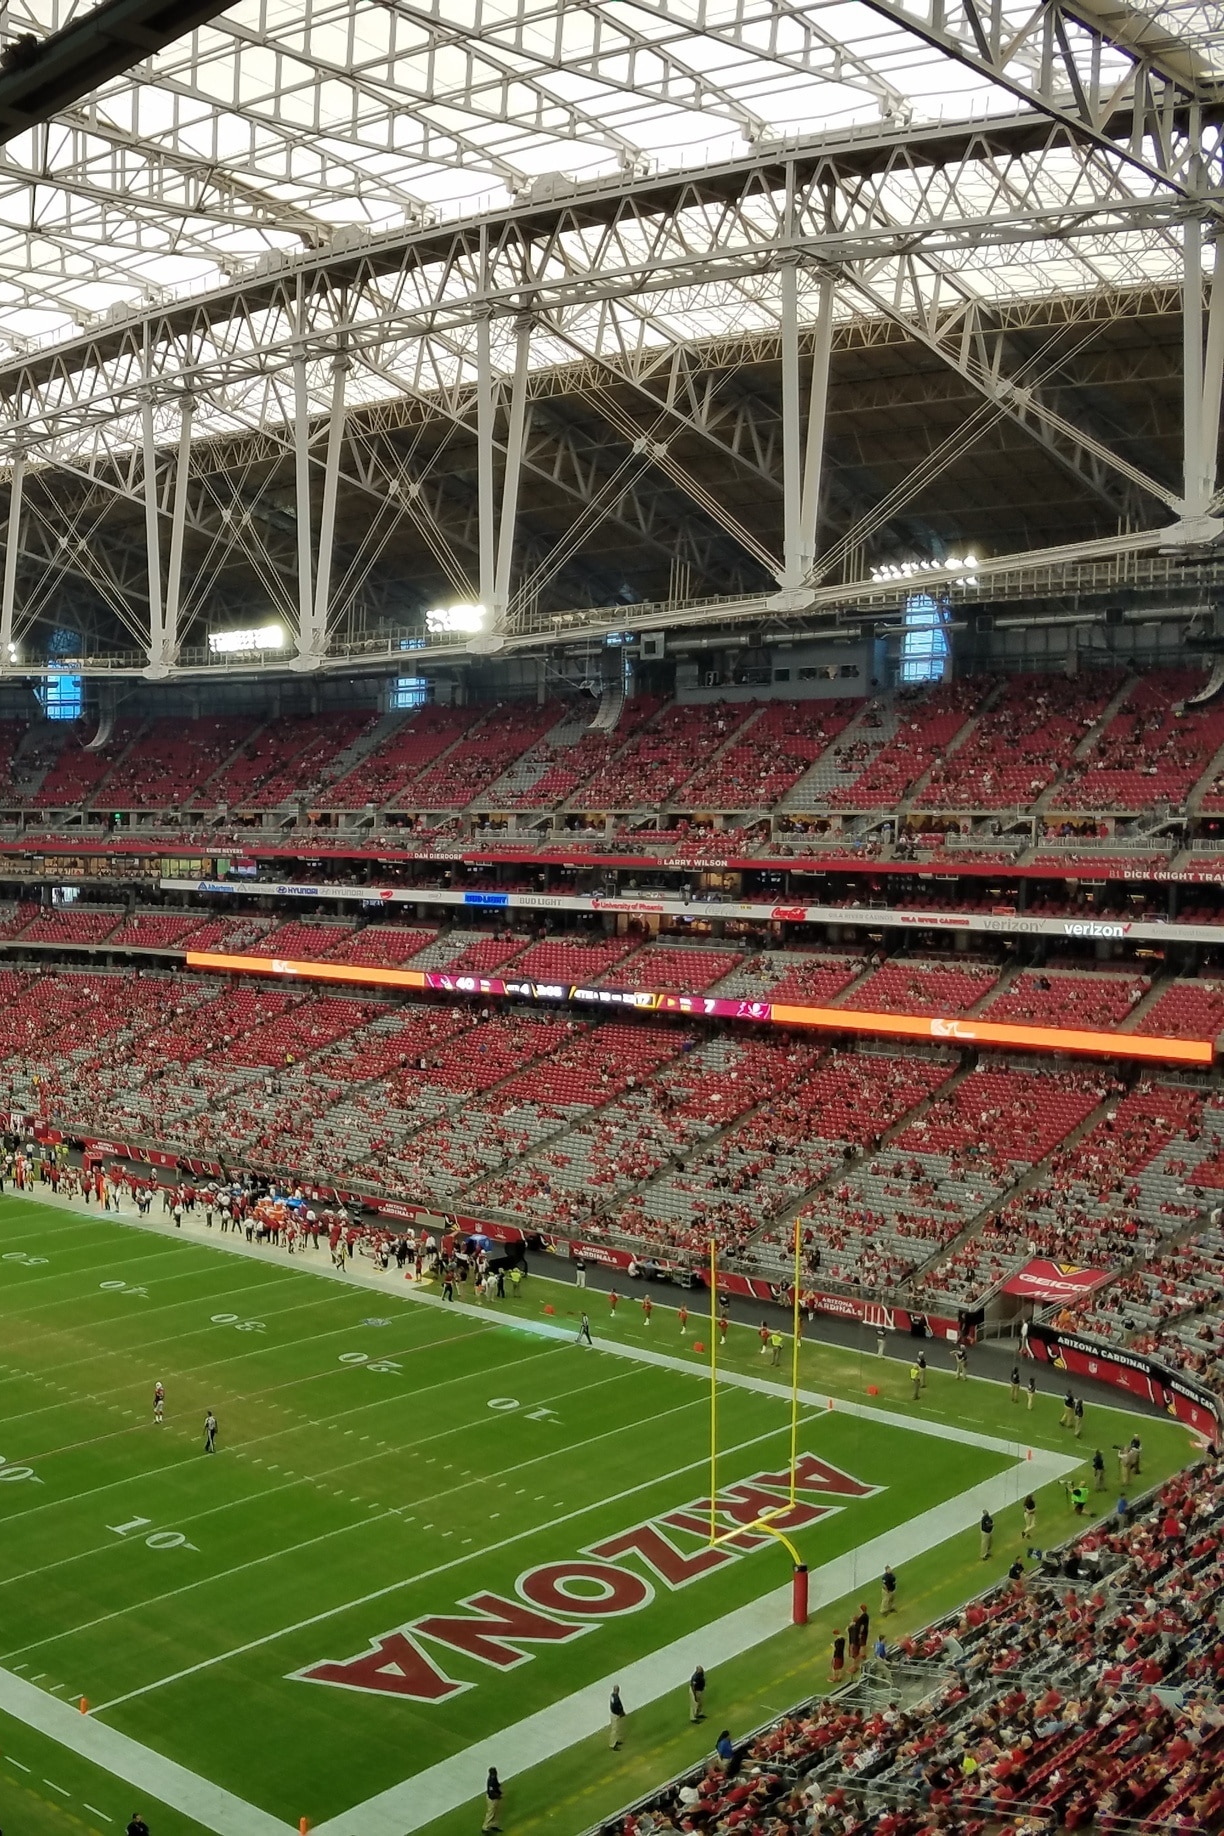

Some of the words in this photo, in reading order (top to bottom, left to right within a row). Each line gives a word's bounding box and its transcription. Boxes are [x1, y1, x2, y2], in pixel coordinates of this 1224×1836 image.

[663, 858, 692, 867] LARRY
[694, 859, 728, 867] WILSON
[1123, 870, 1151, 879] DICK
[1153, 871, 1195, 880] (NIGHT
[287, 886, 319, 895] HYUNDAI
[331, 889, 364, 897] HYUNDAI
[519, 897, 536, 905] BUD
[537, 898, 562, 906] LIGHT
[600, 902, 629, 912] University
[639, 903, 664, 912] Phoenix
[983, 919, 1039, 932] verizon
[1063, 922, 1124, 938] verizon
[455, 976, 475, 990] 40
[703, 998, 716, 1013] 7
[378, 1205, 415, 1219] CARDINALS
[573, 1248, 618, 1264] CARDINALS
[1019, 1273, 1092, 1292] GEICO
[1057, 1335, 1100, 1357] ARIZONA
[1100, 1348, 1152, 1375] CARDINALS
[1170, 1380, 1200, 1403] ARIZONA
[104, 1514, 188, 1551] 10
[282, 1450, 890, 1705] ARIZONA
